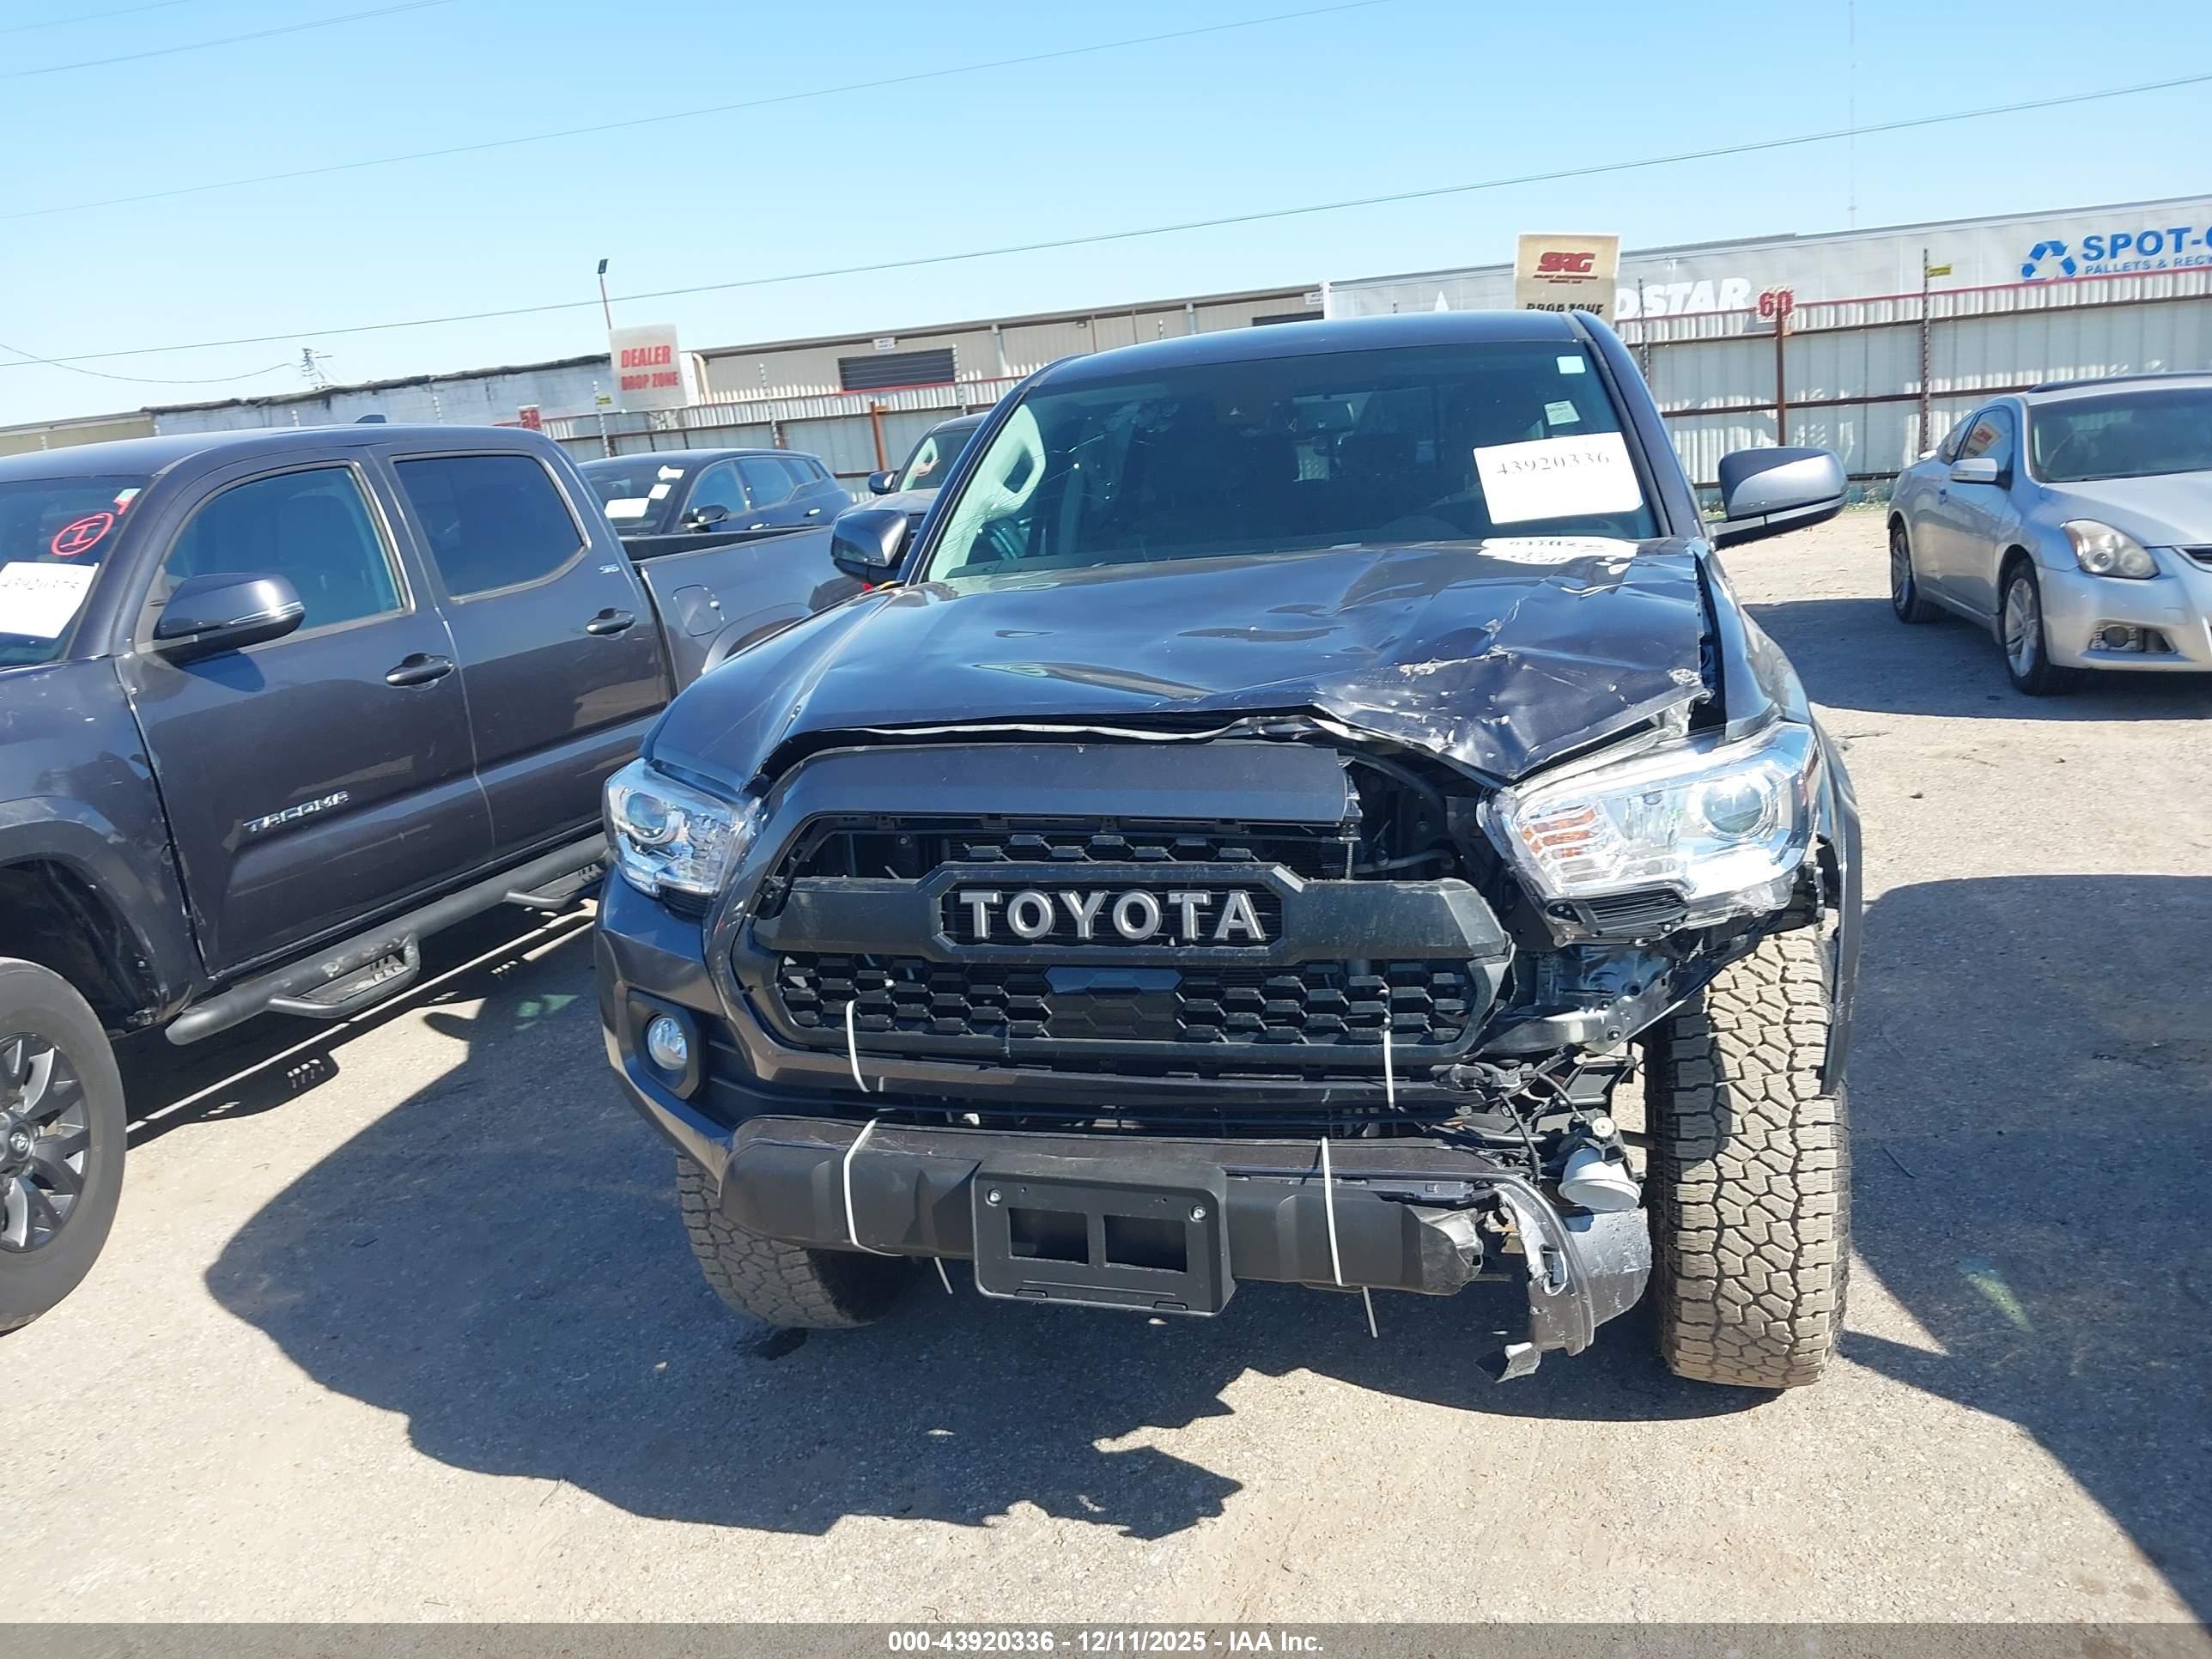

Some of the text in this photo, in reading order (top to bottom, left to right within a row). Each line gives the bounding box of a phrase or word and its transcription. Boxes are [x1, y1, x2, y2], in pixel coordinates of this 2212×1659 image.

[1537, 252, 1596, 273] SRG
[2085, 259, 2152, 275] PALLETS
[2156, 258, 2167, 270] &
[1759, 289, 1794, 318] 60
[621, 344, 672, 368] DEALER
[621, 374, 650, 392] DROP
[1498, 452, 1610, 475] 43920336
[242, 790, 349, 833] TACOMA
[959, 888, 1267, 940] TOYOTA
